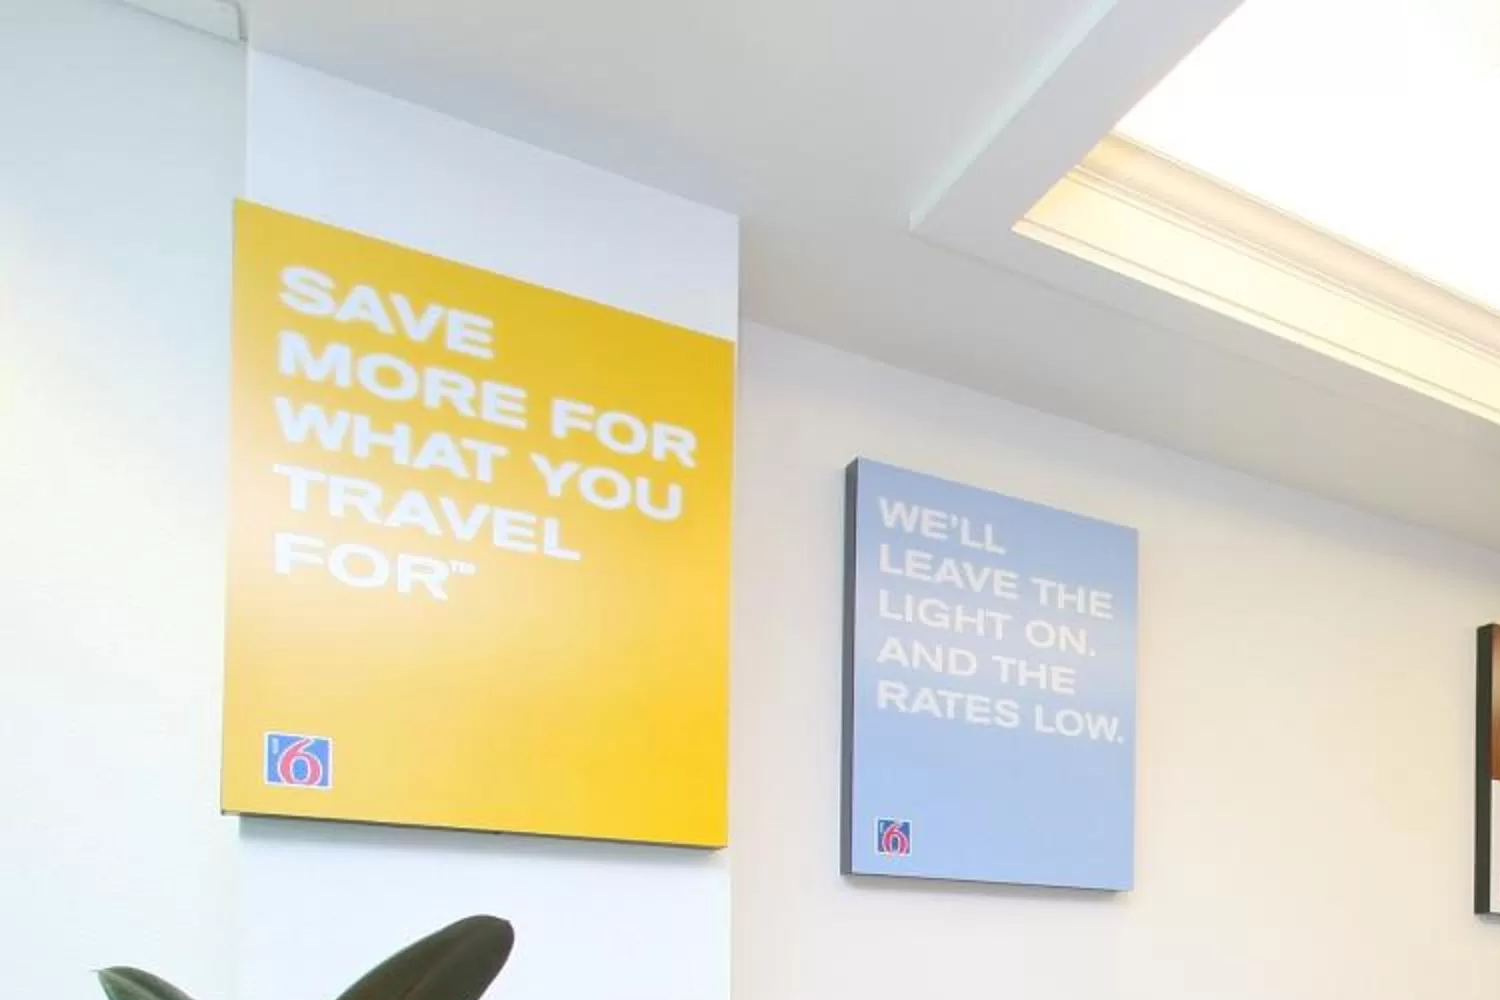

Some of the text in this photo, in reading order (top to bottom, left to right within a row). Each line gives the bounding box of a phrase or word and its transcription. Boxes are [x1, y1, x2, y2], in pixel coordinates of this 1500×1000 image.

[278, 265, 495, 359] SAVE
[277, 330, 698, 467] MORE FOR
[273, 395, 684, 521] WHAT YOU
[272, 464, 582, 561] TRAVEL
[877, 496, 1007, 555] WE'LL
[879, 543, 1114, 620] LEAVE THE
[879, 589, 1097, 656] LIGHT ON.
[876, 636, 1076, 695] AND THE
[877, 680, 1126, 744] RATES LOW.
